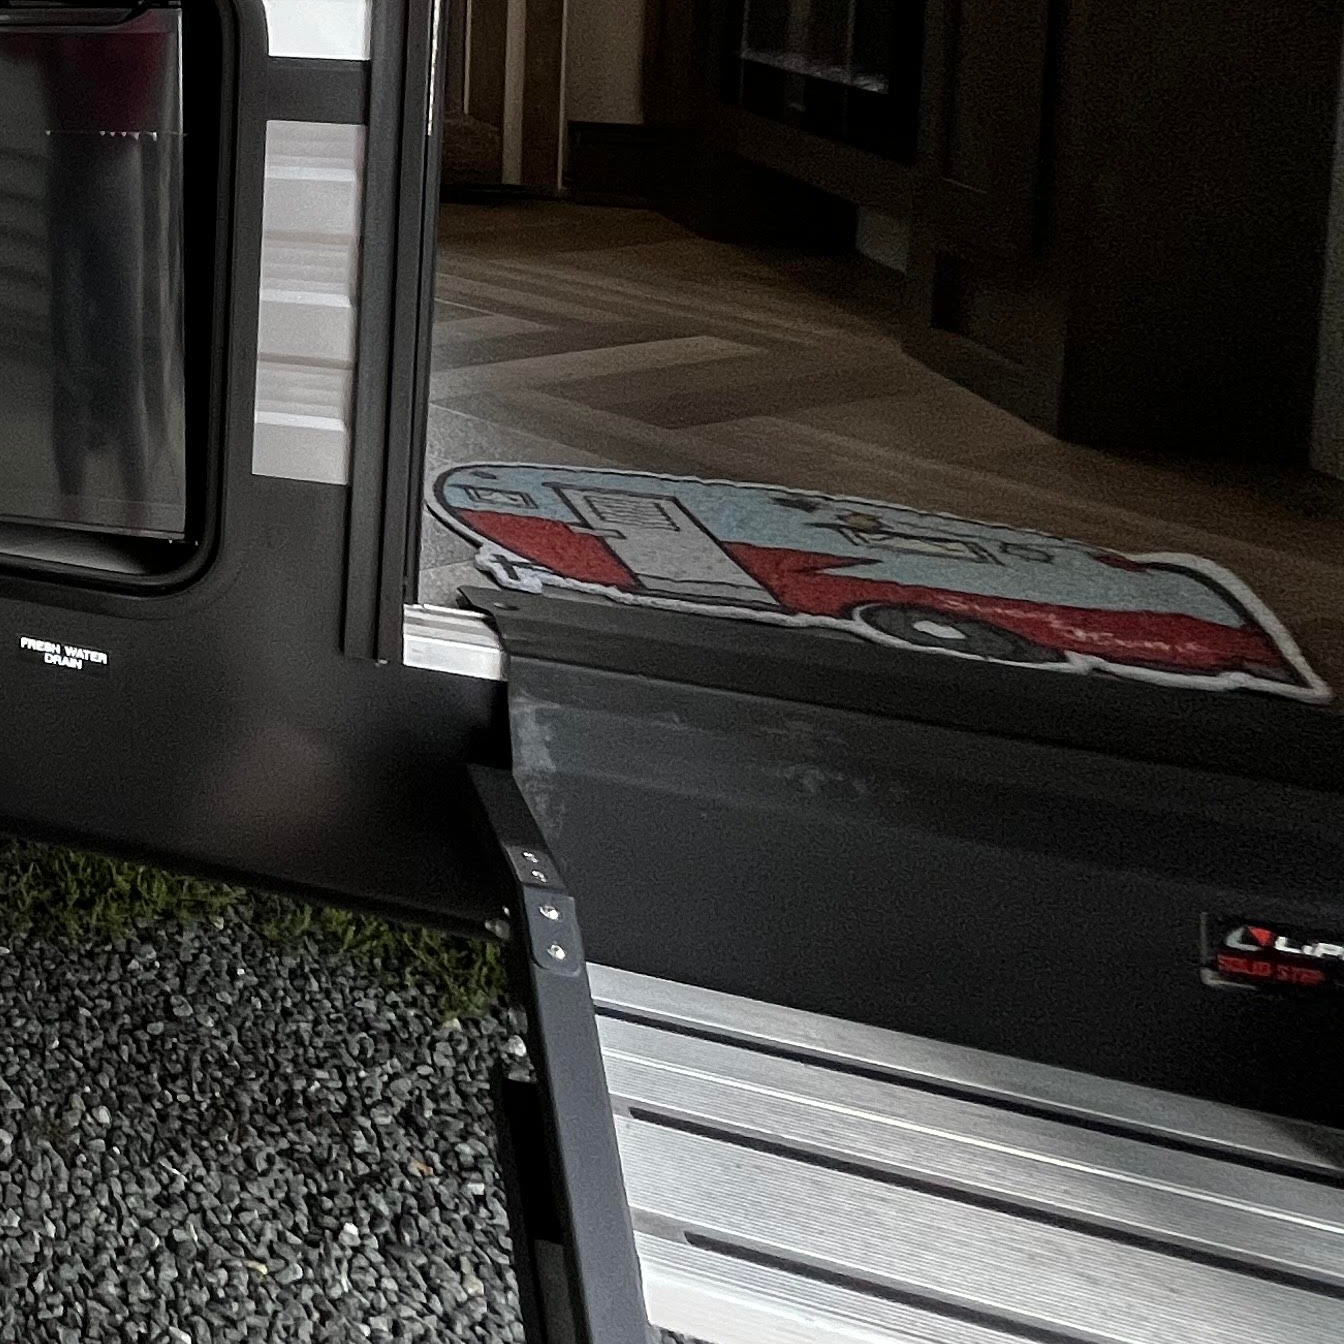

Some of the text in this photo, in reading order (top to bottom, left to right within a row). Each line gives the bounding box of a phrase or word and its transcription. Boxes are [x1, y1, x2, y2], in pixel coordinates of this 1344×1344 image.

[20, 636, 108, 665] FRESH WATER
[44, 652, 83, 670] DRAIN
